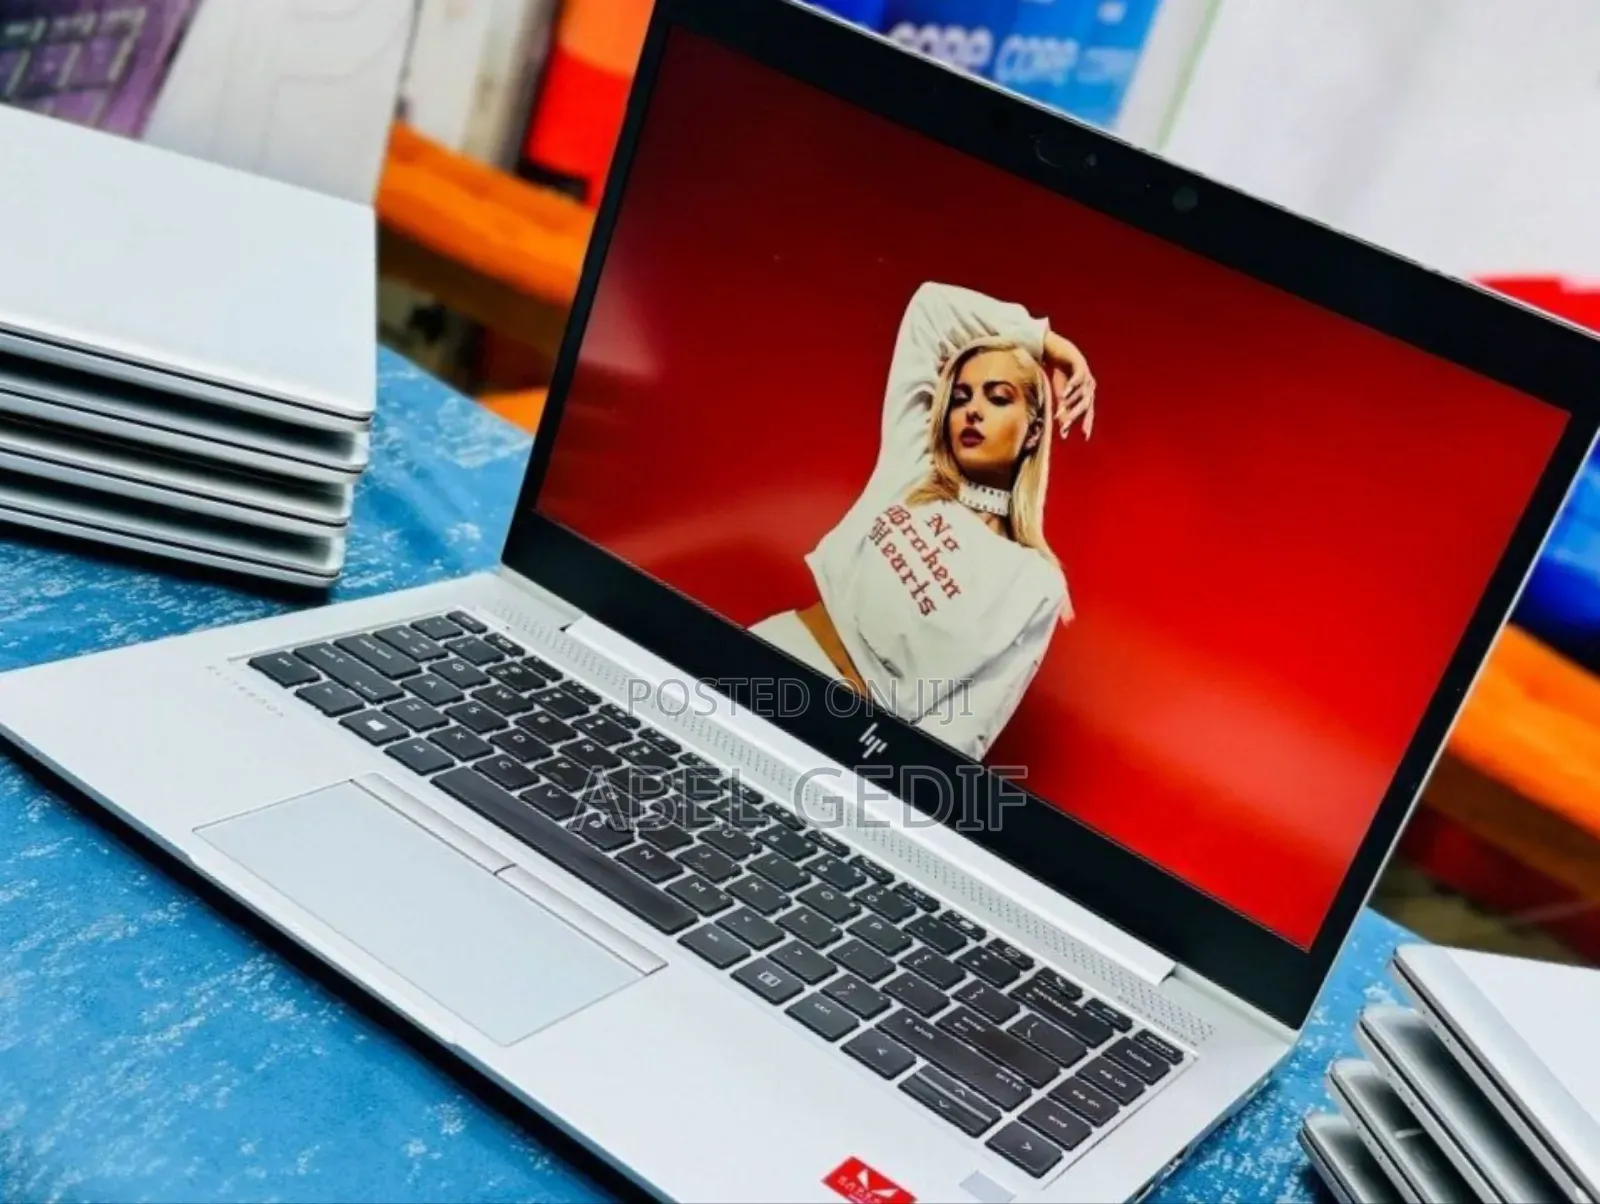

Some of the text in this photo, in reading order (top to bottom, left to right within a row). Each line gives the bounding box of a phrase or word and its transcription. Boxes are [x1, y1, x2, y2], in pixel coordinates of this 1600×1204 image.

[923, 513, 960, 552] No
[883, 505, 961, 600] Broken
[868, 517, 937, 616] Hearts
[452, 663, 465, 672] Q
[497, 690, 512, 699] W
[455, 732, 465, 740] X
[512, 734, 526, 742] D
[498, 760, 512, 769] C
[547, 790, 558, 798] V
[589, 820, 604, 829] B
[640, 850, 654, 860] N
[691, 882, 706, 892] M
[749, 882, 760, 891] K
[820, 891, 834, 900] O
[870, 922, 883, 930] P
[1126, 1049, 1152, 1068] home
[1048, 1115, 1067, 1128] end
